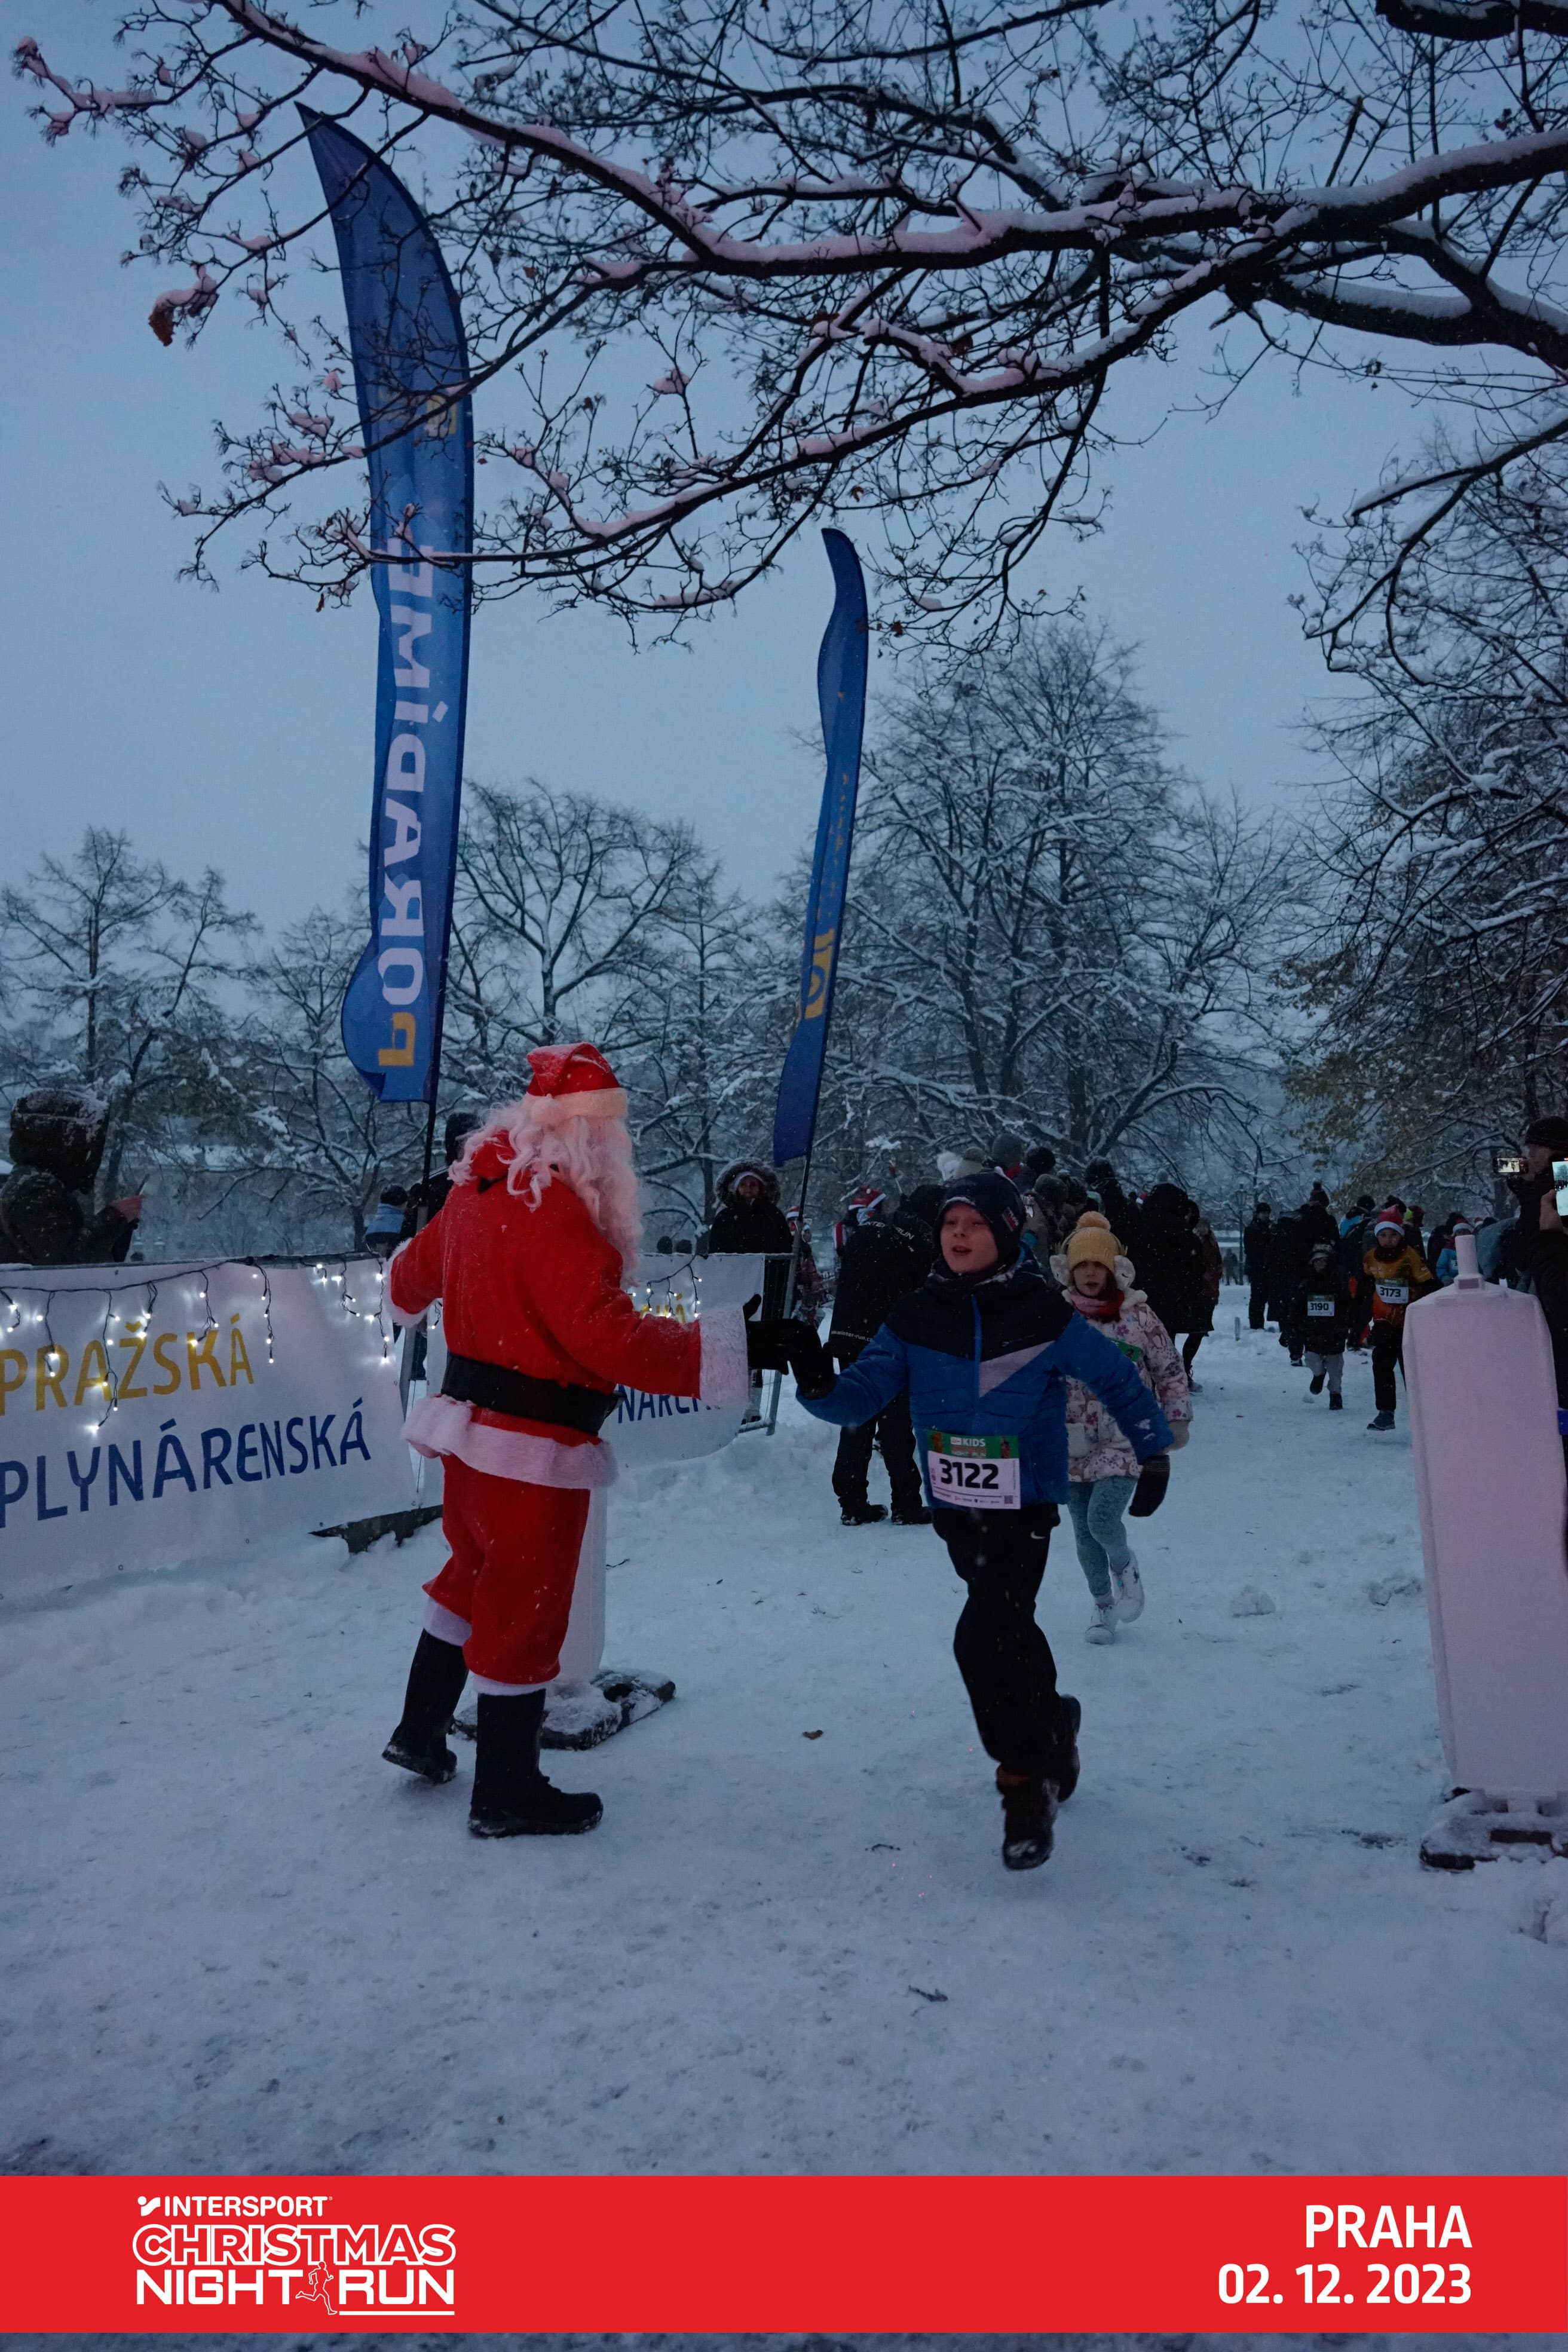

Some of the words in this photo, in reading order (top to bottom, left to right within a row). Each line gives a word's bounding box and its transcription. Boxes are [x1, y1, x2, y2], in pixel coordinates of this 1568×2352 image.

[1380, 1287, 1401, 1297] 3173
[0, 1313, 254, 1416] PRAŽSKÁ
[963, 1438, 985, 1447] KIDS
[0, 1397, 371, 1529] PLYNÁRENSKÁ
[939, 1458, 999, 1489] 3122
